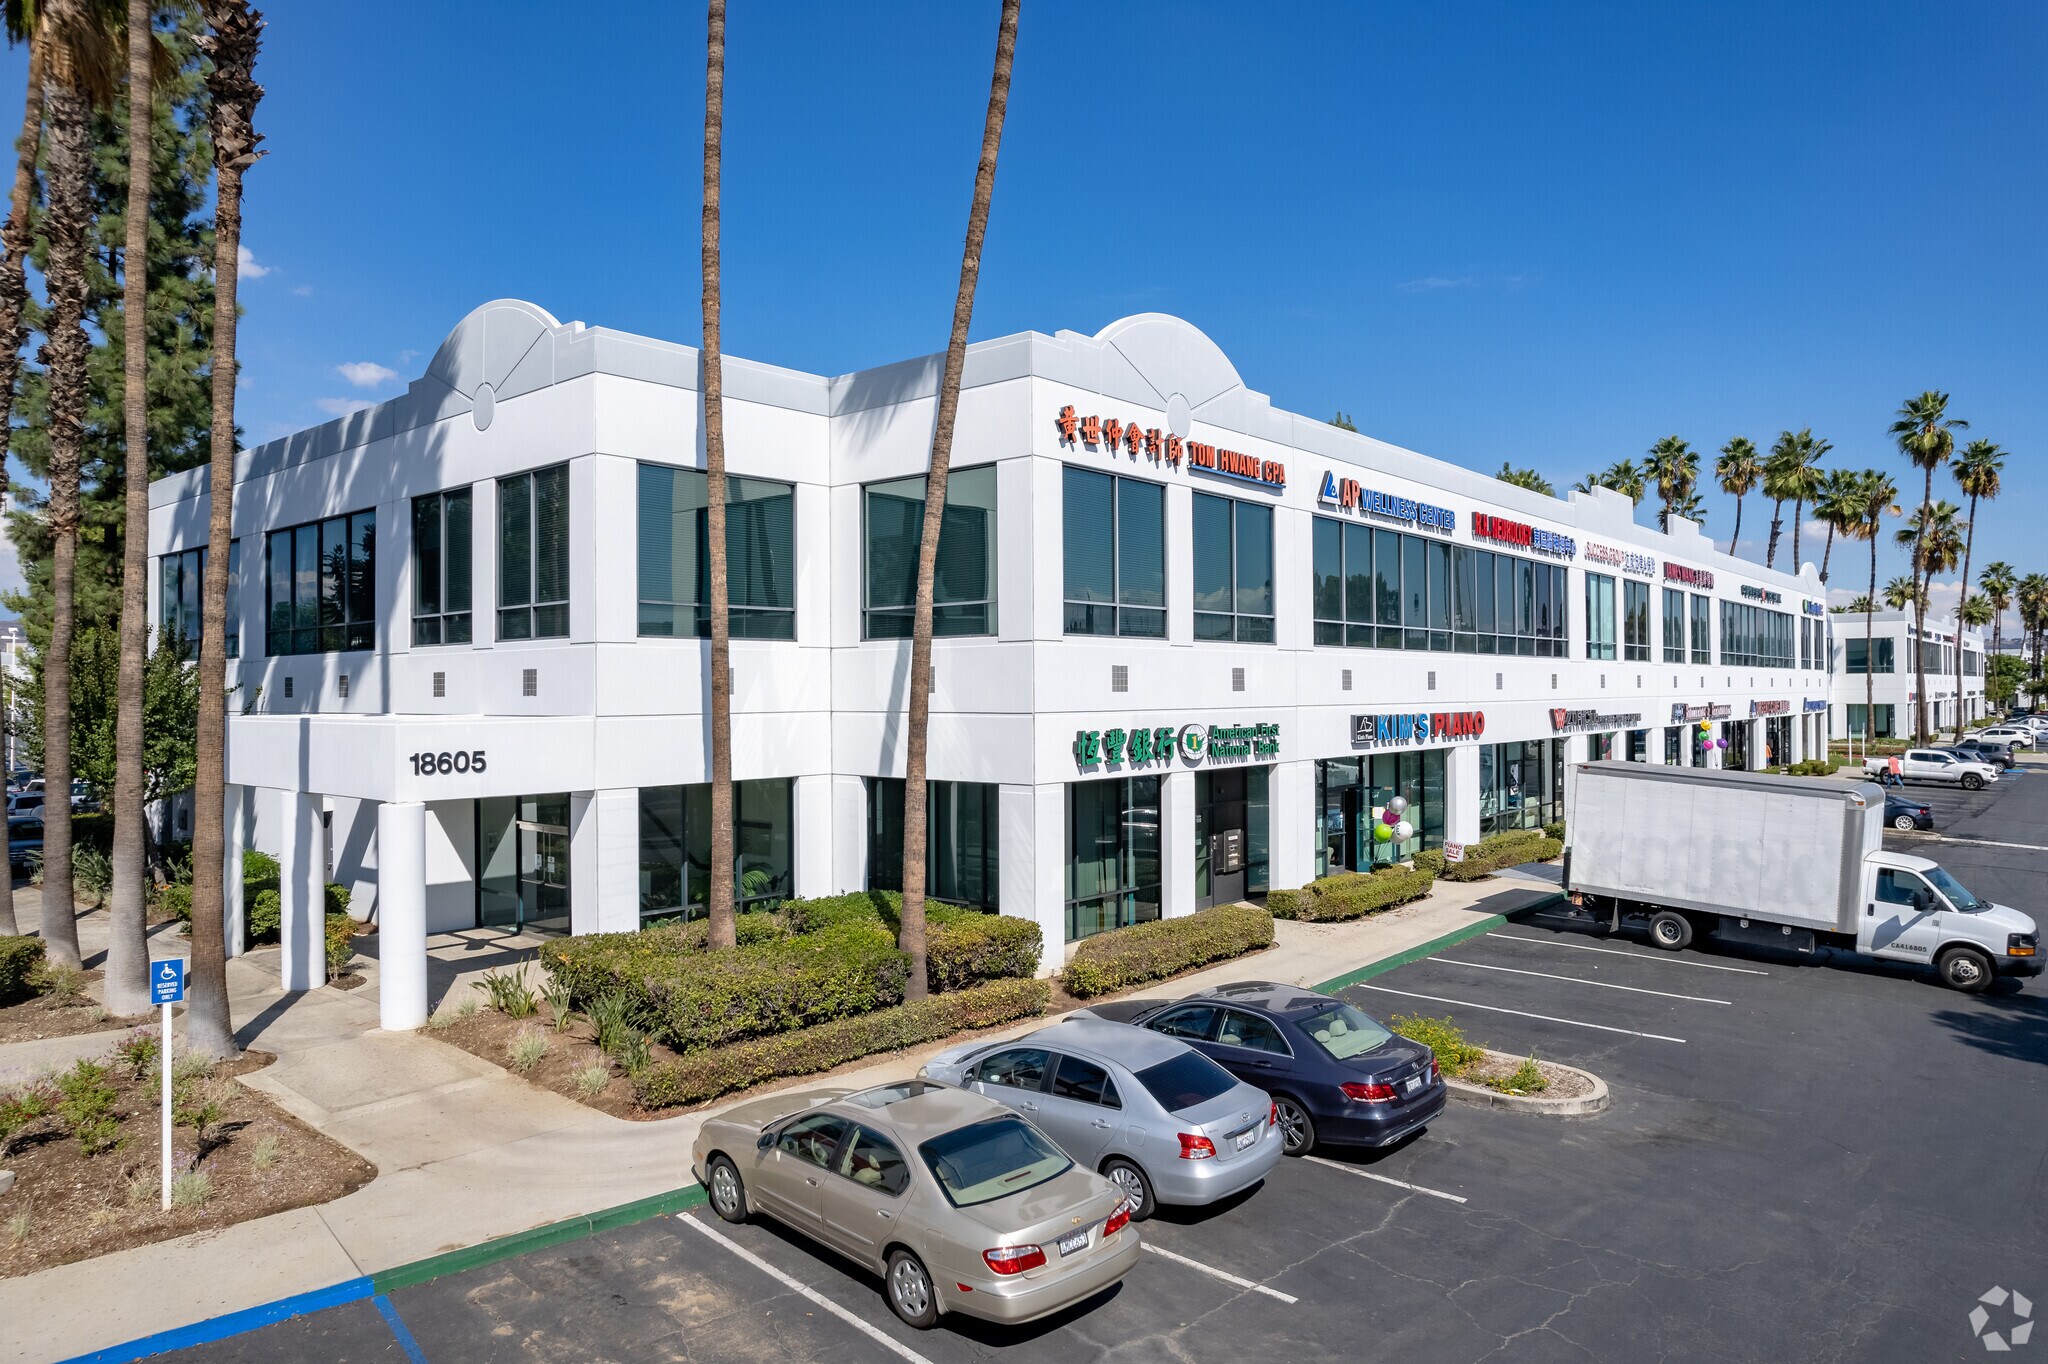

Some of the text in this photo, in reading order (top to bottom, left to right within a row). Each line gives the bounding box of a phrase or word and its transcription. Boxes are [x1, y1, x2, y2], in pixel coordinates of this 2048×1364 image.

[1188, 440, 1286, 484] TOM HWANG CPA
[1340, 477, 1456, 530] AP WELLNESS CENTER
[1209, 722, 1280, 740] American First
[1375, 711, 1485, 741] KIM'S PIANO
[1209, 738, 1280, 758] National Bank
[409, 750, 487, 776] 18605
[1444, 841, 1463, 851] PIANO
[1445, 847, 1460, 856] SALE
